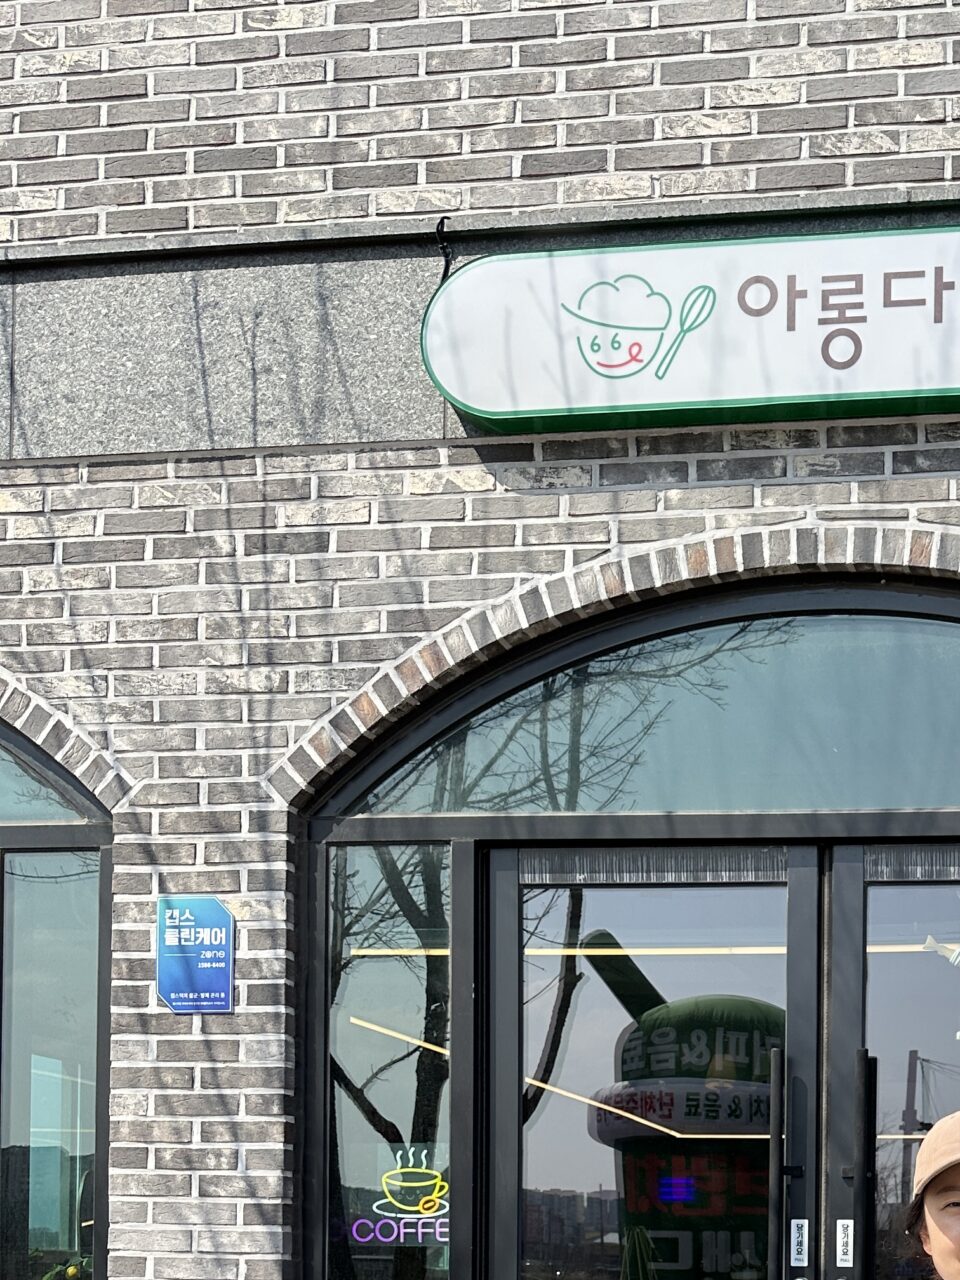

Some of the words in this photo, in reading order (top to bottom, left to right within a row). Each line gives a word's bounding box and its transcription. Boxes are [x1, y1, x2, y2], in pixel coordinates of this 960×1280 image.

[165, 908, 195, 926] 캡스
[164, 927, 226, 946] 클린케어
[351, 1218, 449, 1243] COFFE
[796, 1223, 804, 1256] 당기세요
[841, 1223, 850, 1256] 당기세요
